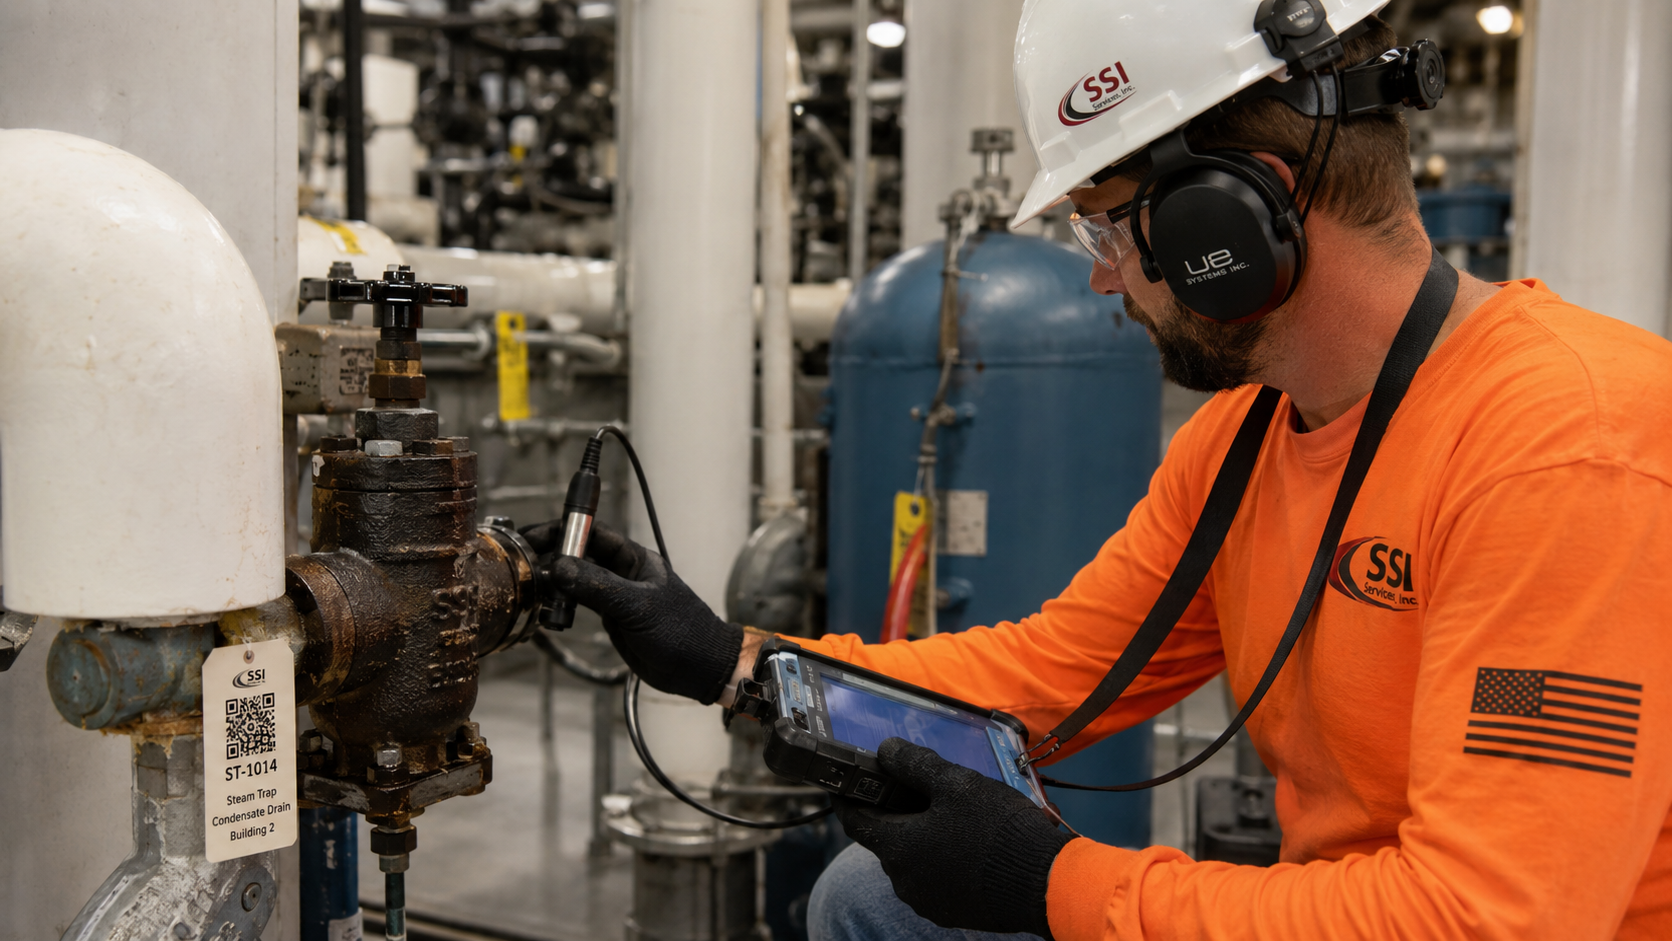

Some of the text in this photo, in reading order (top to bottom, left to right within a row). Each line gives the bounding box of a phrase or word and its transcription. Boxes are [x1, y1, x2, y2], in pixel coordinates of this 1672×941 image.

[1083, 61, 1130, 103] SSI
[1185, 262, 1250, 286] SYSTEMS INC.
[1366, 543, 1414, 592] SSI
[247, 669, 265, 682] SSI
[225, 758, 278, 781] ST-1014
[226, 788, 277, 806] Steam Trap
[212, 802, 291, 827] Condensate Drain
[230, 822, 275, 841] Building 2
